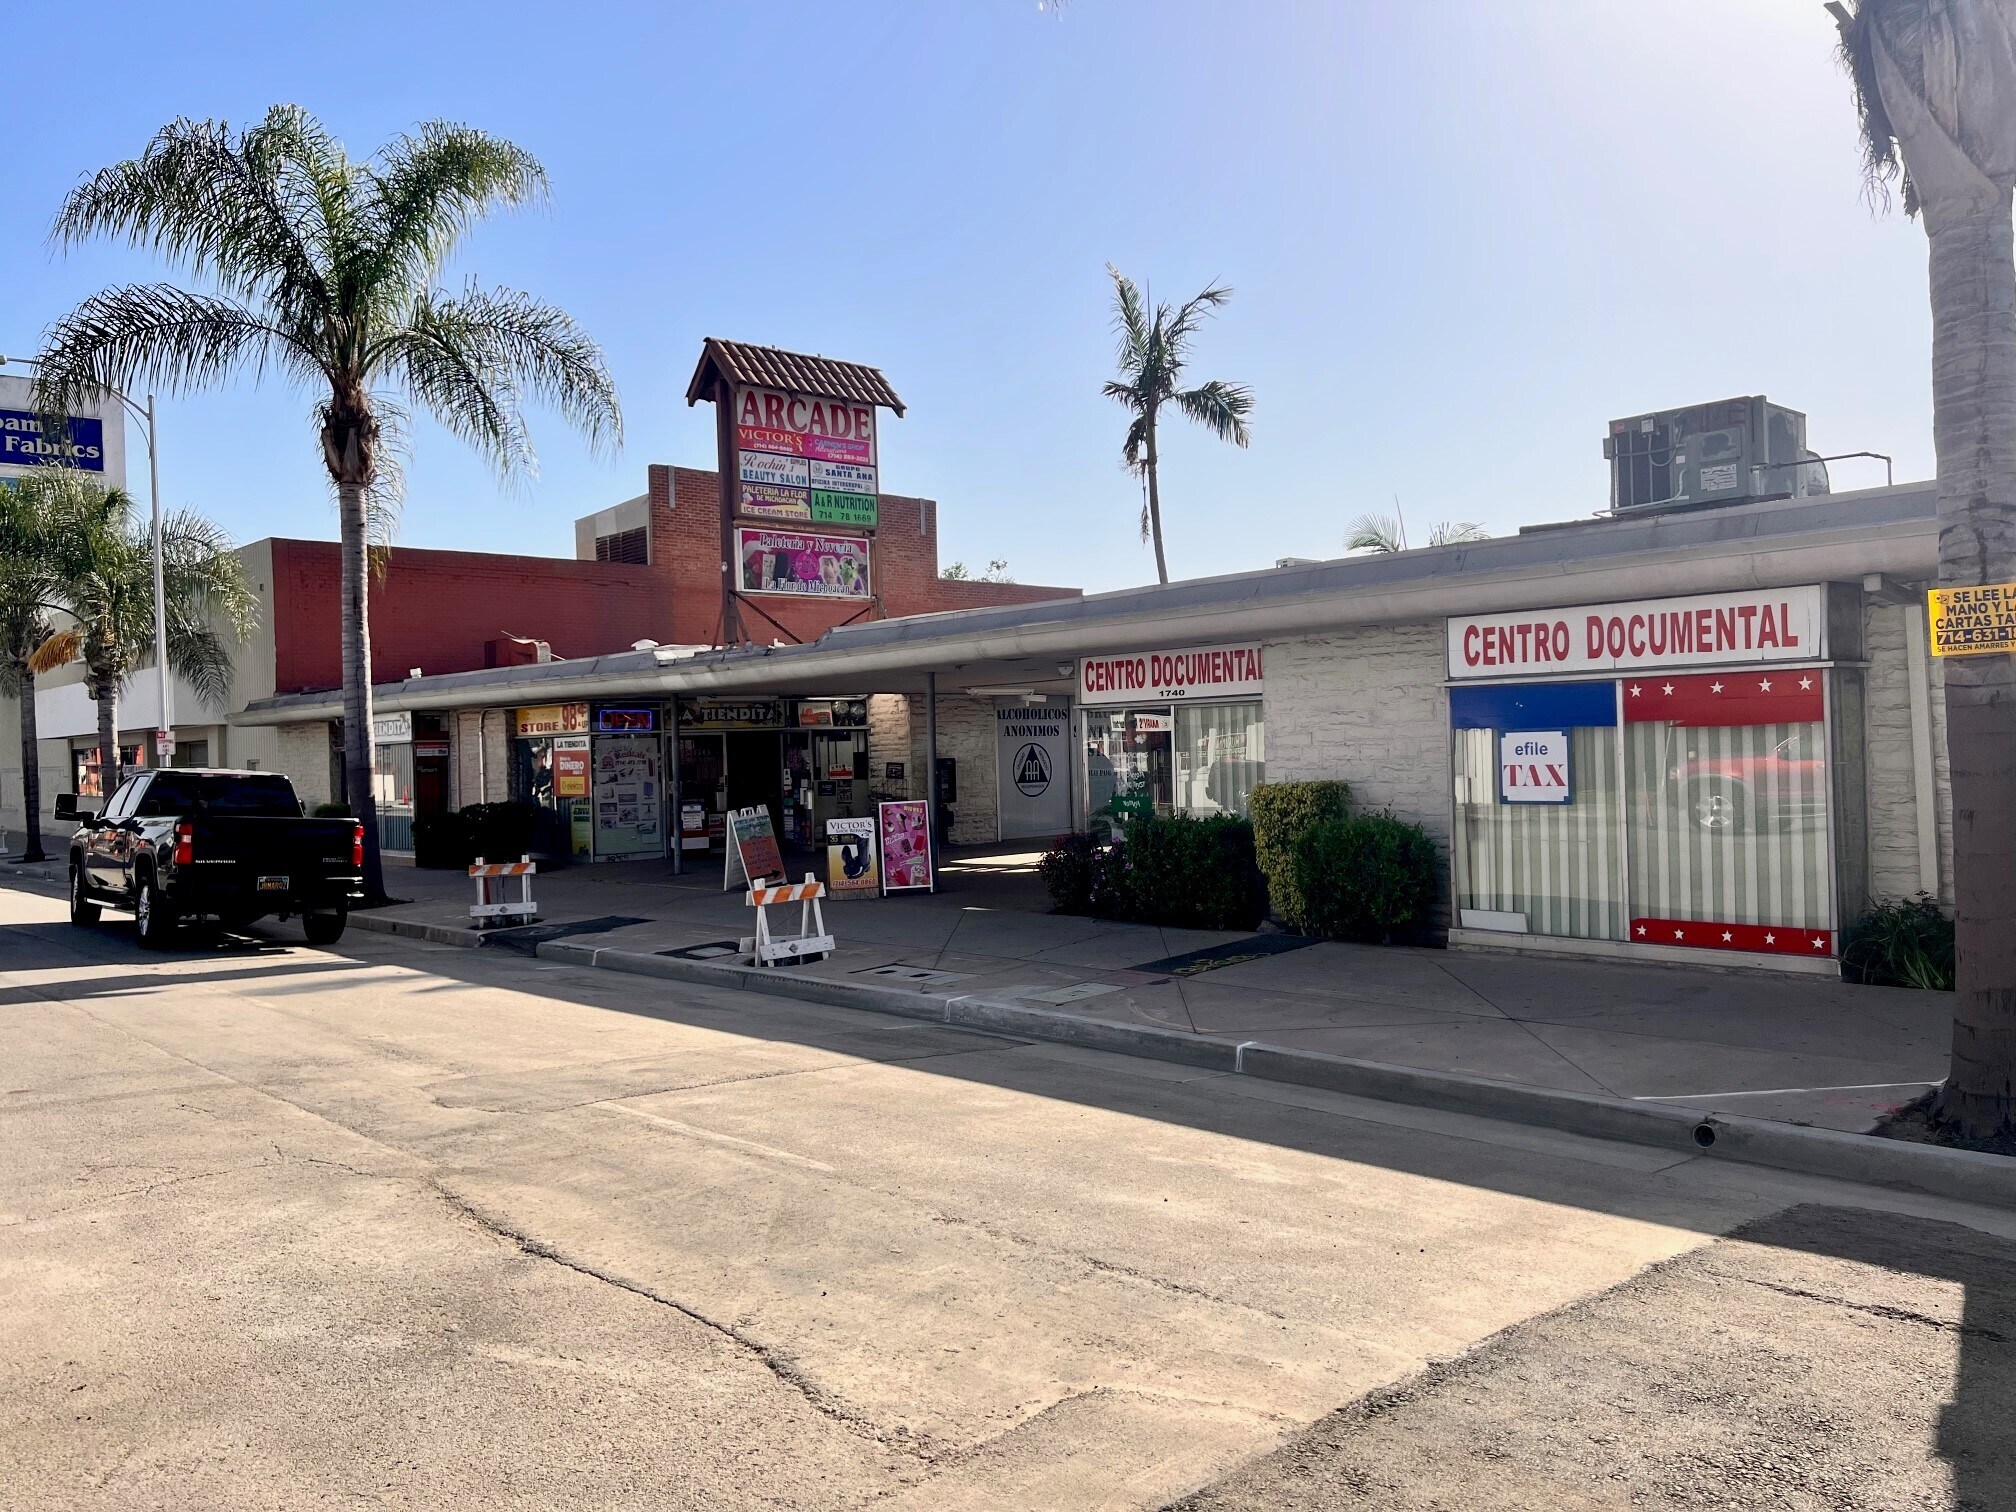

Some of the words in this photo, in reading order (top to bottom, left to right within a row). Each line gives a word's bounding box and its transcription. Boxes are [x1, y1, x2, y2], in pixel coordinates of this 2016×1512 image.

[740, 390, 871, 440] ARCADE
[739, 428, 803, 446] VICTOR'S
[5, 435, 100, 458] Fabrics
[825, 469, 853, 479] SANTA
[856, 472, 873, 480] ANA
[836, 464, 861, 472] GRUPO
[743, 469, 776, 482] BEAUTY
[780, 473, 807, 485] SALON
[742, 485, 779, 496] PALETERIA
[780, 488, 789, 497] LA
[790, 489, 807, 499] FLOR
[815, 493, 820, 506] A
[827, 495, 833, 507] R
[834, 495, 875, 512] NUTRITION
[743, 506, 756, 514] ICE
[757, 507, 783, 516] CREAM
[785, 509, 809, 518] STORE
[819, 510, 832, 519] 714
[840, 512, 850, 521] 78
[1953, 591, 1971, 603] SE
[1974, 589, 2000, 602] LEE
[1946, 602, 1989, 616] MANO
[1992, 601, 2001, 613] Y
[1935, 614, 1993, 629] CARTAS
[1995, 613, 2016, 625] TA
[1463, 620, 1570, 667] CENTRO
[1586, 602, 1799, 660] DOCUMENTAL
[1938, 645, 1946, 653] SE
[1974, 642, 2009, 650] AMARRES
[1085, 658, 1146, 692] CENTRO
[1158, 689, 1185, 697] 1740
[701, 707, 774, 720] TIENDITA
[521, 721, 559, 732] STORE
[602, 712, 650, 729] OPEN
[1003, 724, 1060, 737] ANONIMOS
[564, 740, 587, 748] TIENDITA
[1515, 742, 1549, 755] efile
[560, 760, 584, 771] DINERO
[1503, 764, 1566, 786] TAX
[830, 820, 872, 830] VICTOR'S
